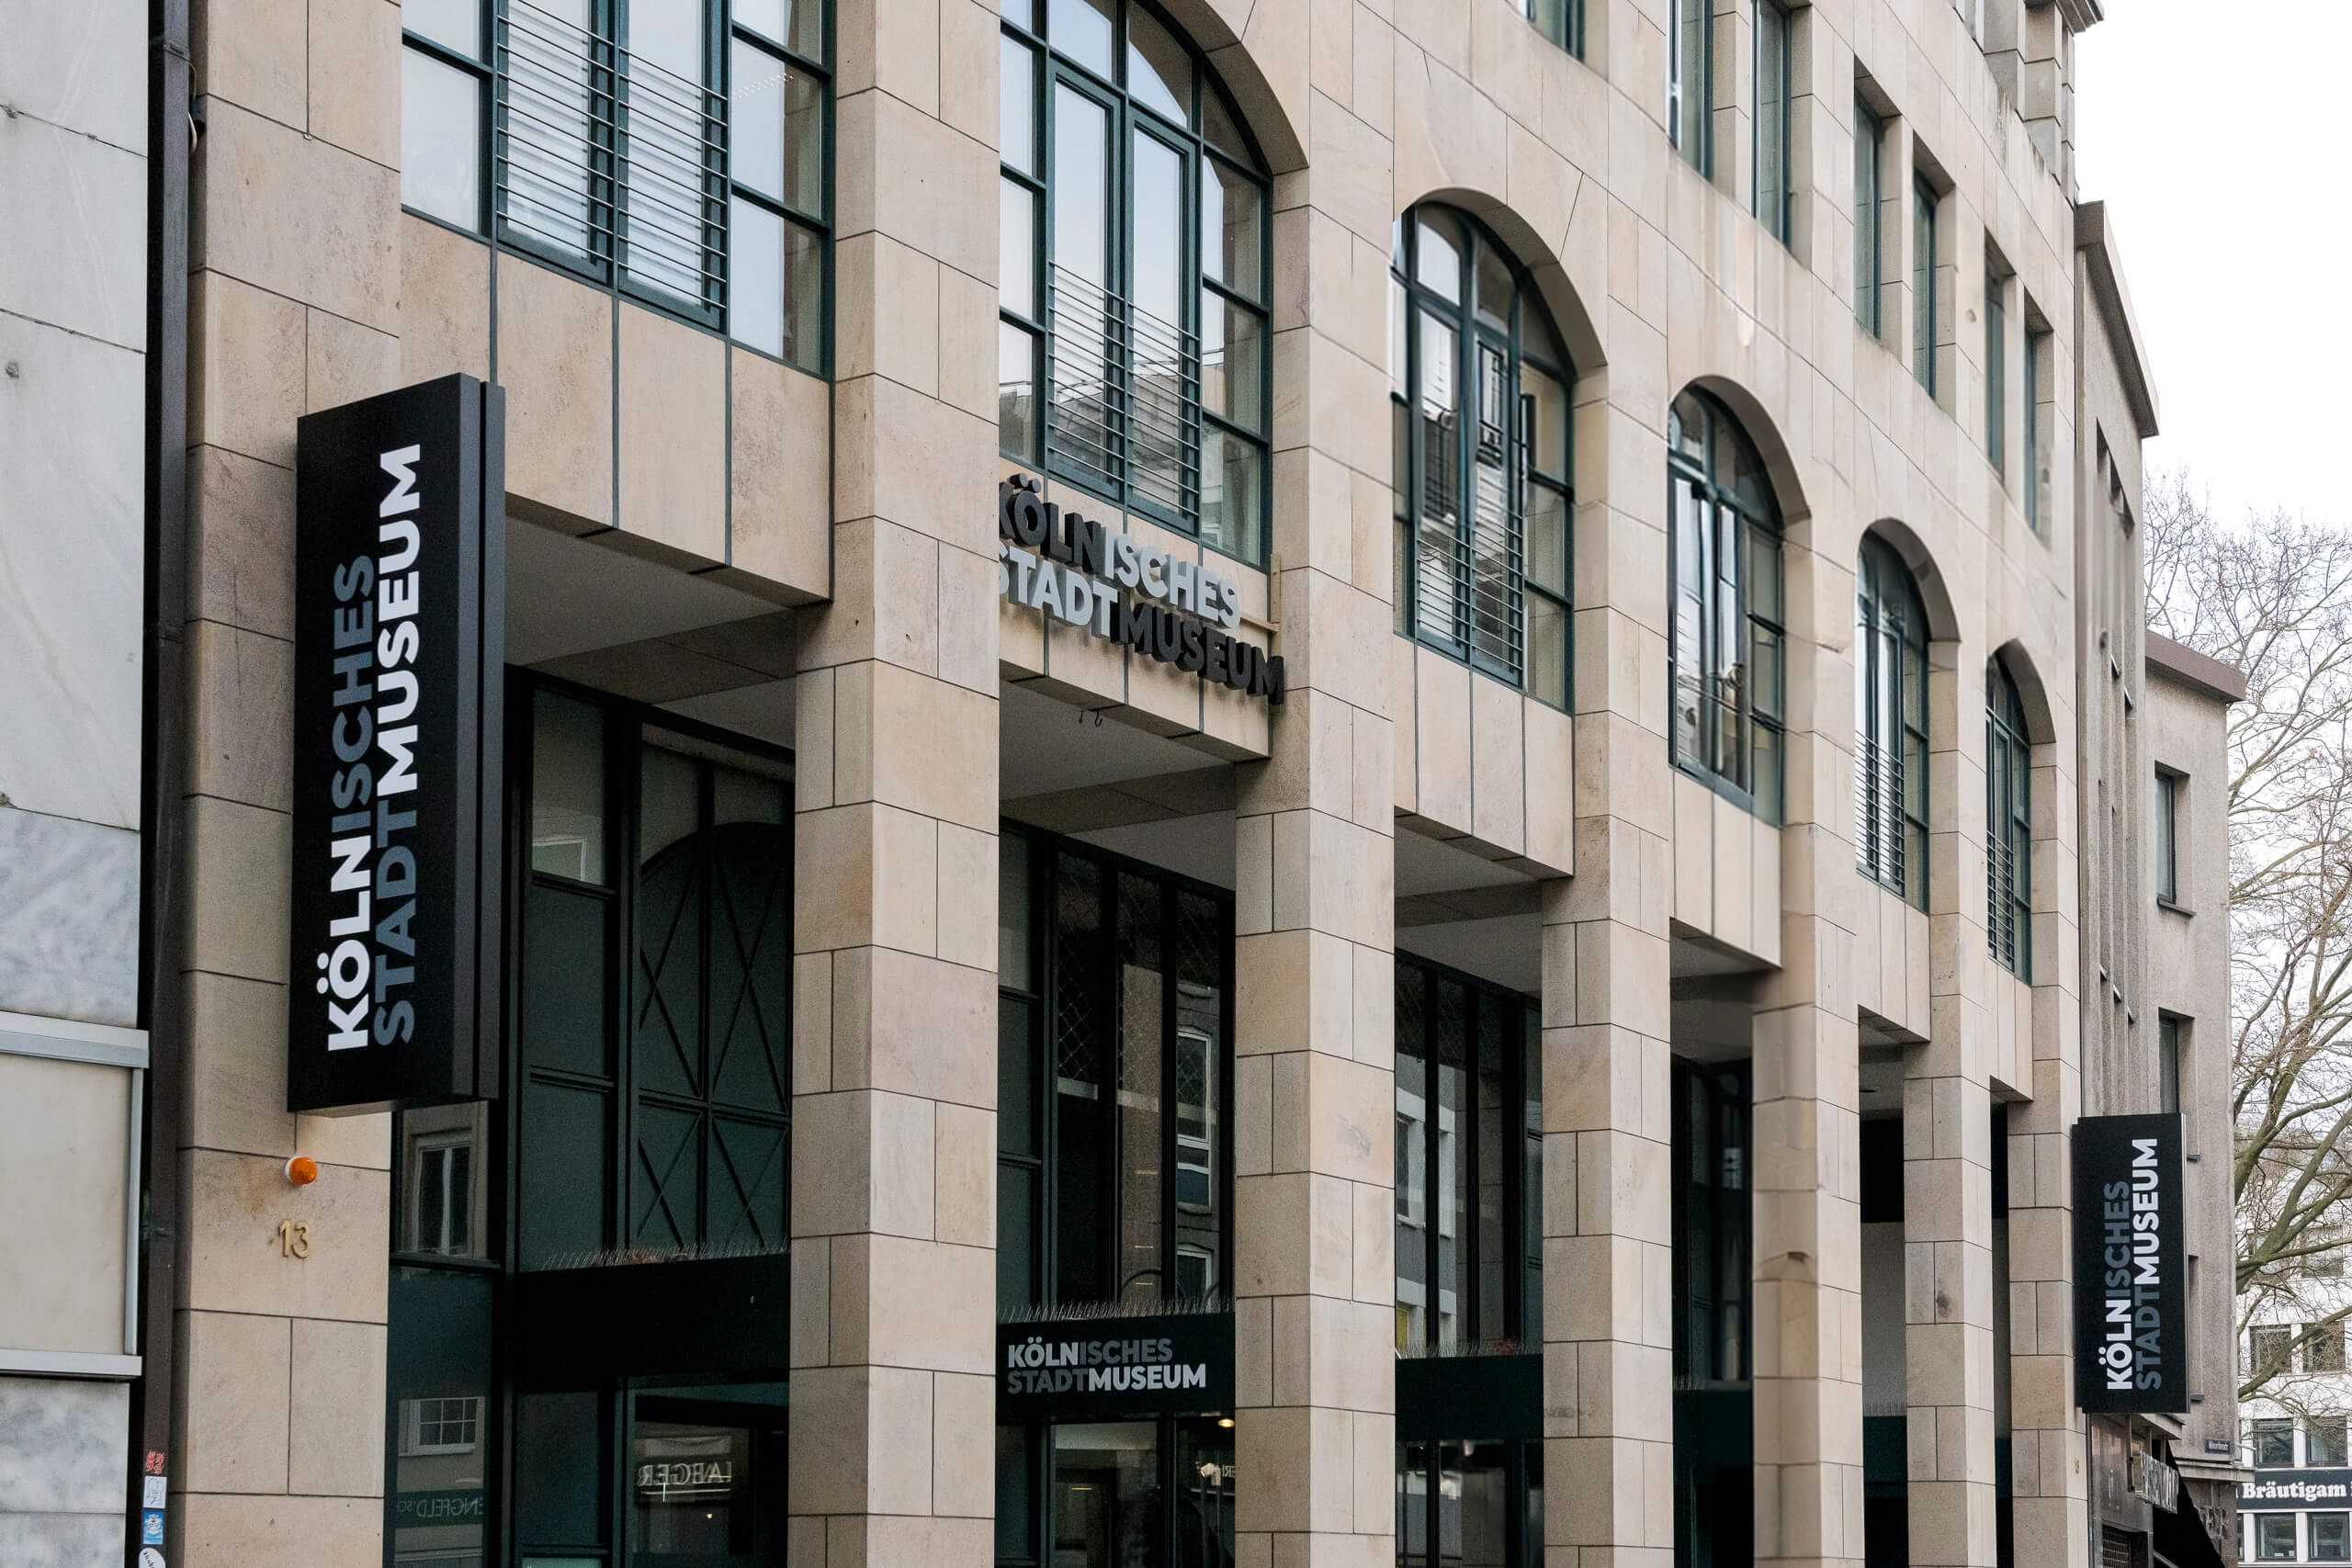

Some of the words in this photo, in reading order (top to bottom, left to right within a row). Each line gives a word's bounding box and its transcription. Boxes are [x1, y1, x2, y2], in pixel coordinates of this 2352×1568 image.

[316, 555, 374, 1051] KÖLNISCHES
[373, 444, 421, 1046] STADTMUSEUM
[278, 1219, 310, 1259] 13
[2098, 1180, 2133, 1390] KÖLNISCHES
[2132, 1138, 2162, 1390] STADTMUSEUM
[1007, 1363, 1206, 1394] STADTMUSEUM
[1008, 1337, 1173, 1368] KÖLNISCHES
[2242, 1481, 2347, 1502] Bräutigam
